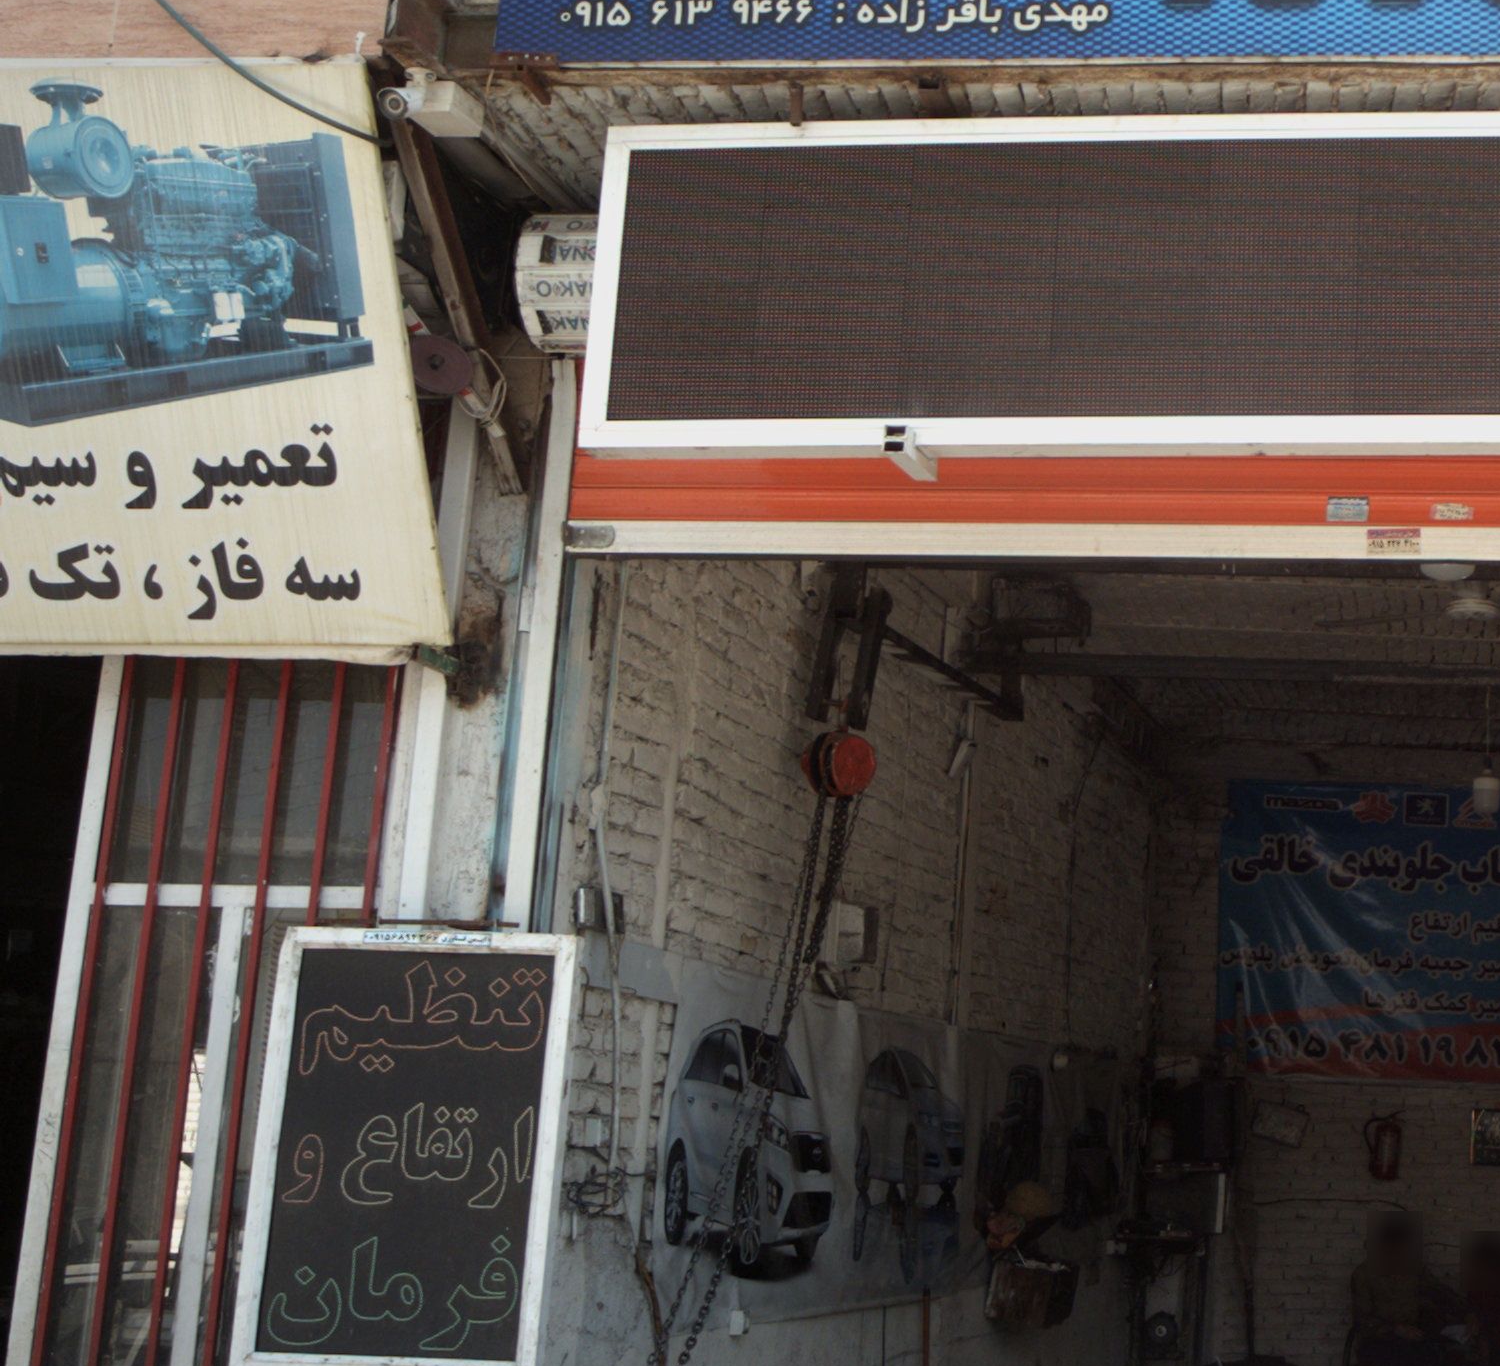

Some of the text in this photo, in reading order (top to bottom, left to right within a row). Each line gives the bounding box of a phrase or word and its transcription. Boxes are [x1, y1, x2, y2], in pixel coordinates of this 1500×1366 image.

[1013, 1, 1109, 31] مهدی
[125, 450, 157, 510] و
[181, 422, 338, 510] تعمیر
[28, 542, 121, 601] تک
[187, 536, 265, 620] فاز
[285, 555, 361, 601] سه
[1232, 835, 1320, 882] خالقی
[1330, 842, 1452, 892] جلوبندی
[1410, 912, 1468, 942] ارتفاع
[1420, 954, 1469, 979] جعبه
[299, 960, 547, 1075] تنظیم
[1425, 991, 1469, 1014] کمک
[282, 1102, 534, 1208] ارتفاع و
[266, 1234, 519, 1352] فرمان
